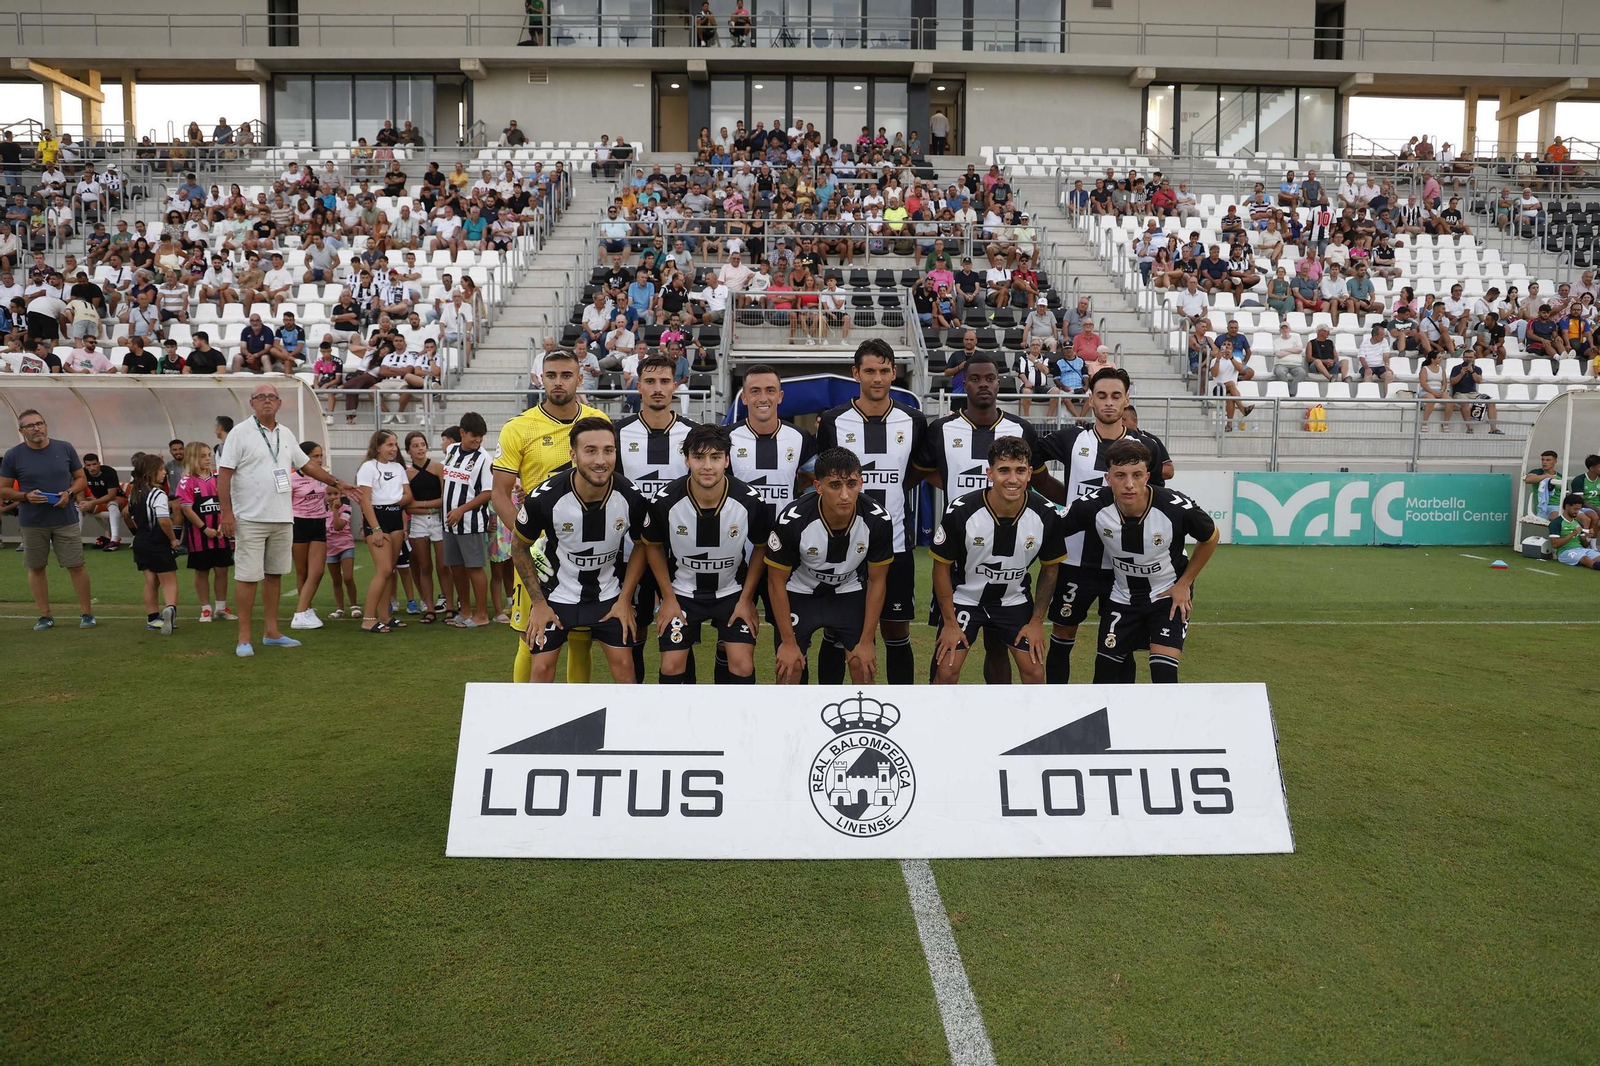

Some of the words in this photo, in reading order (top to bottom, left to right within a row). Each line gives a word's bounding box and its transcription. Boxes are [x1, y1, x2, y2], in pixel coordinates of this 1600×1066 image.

[1317, 211, 1330, 227] 10
[449, 471, 470, 481] CEPSA
[861, 473, 899, 484] OTUS
[957, 477, 995, 488] LOTU
[756, 488, 789, 499] TUS
[200, 503, 221, 513] LOTU
[1405, 497, 1466, 509] Marbella
[1405, 510, 1460, 522] Football
[1463, 511, 1509, 522] Center
[567, 551, 617, 567] LOTUS
[681, 558, 735, 571] LOTUS
[1112, 557, 1162, 575] LOTUS
[808, 568, 851, 582] OTU
[975, 566, 1025, 580] LOTUS
[512, 583, 522, 607] 1
[1062, 582, 1079, 603] 3
[957, 610, 970, 632] 9
[1110, 611, 1122, 633] 7
[812, 758, 831, 793] REAL
[829, 736, 911, 789] BALOMPEDICA
[481, 768, 723, 817] LOTUS
[1000, 768, 1233, 817] LOTUS
[836, 815, 895, 834] LINENSE
